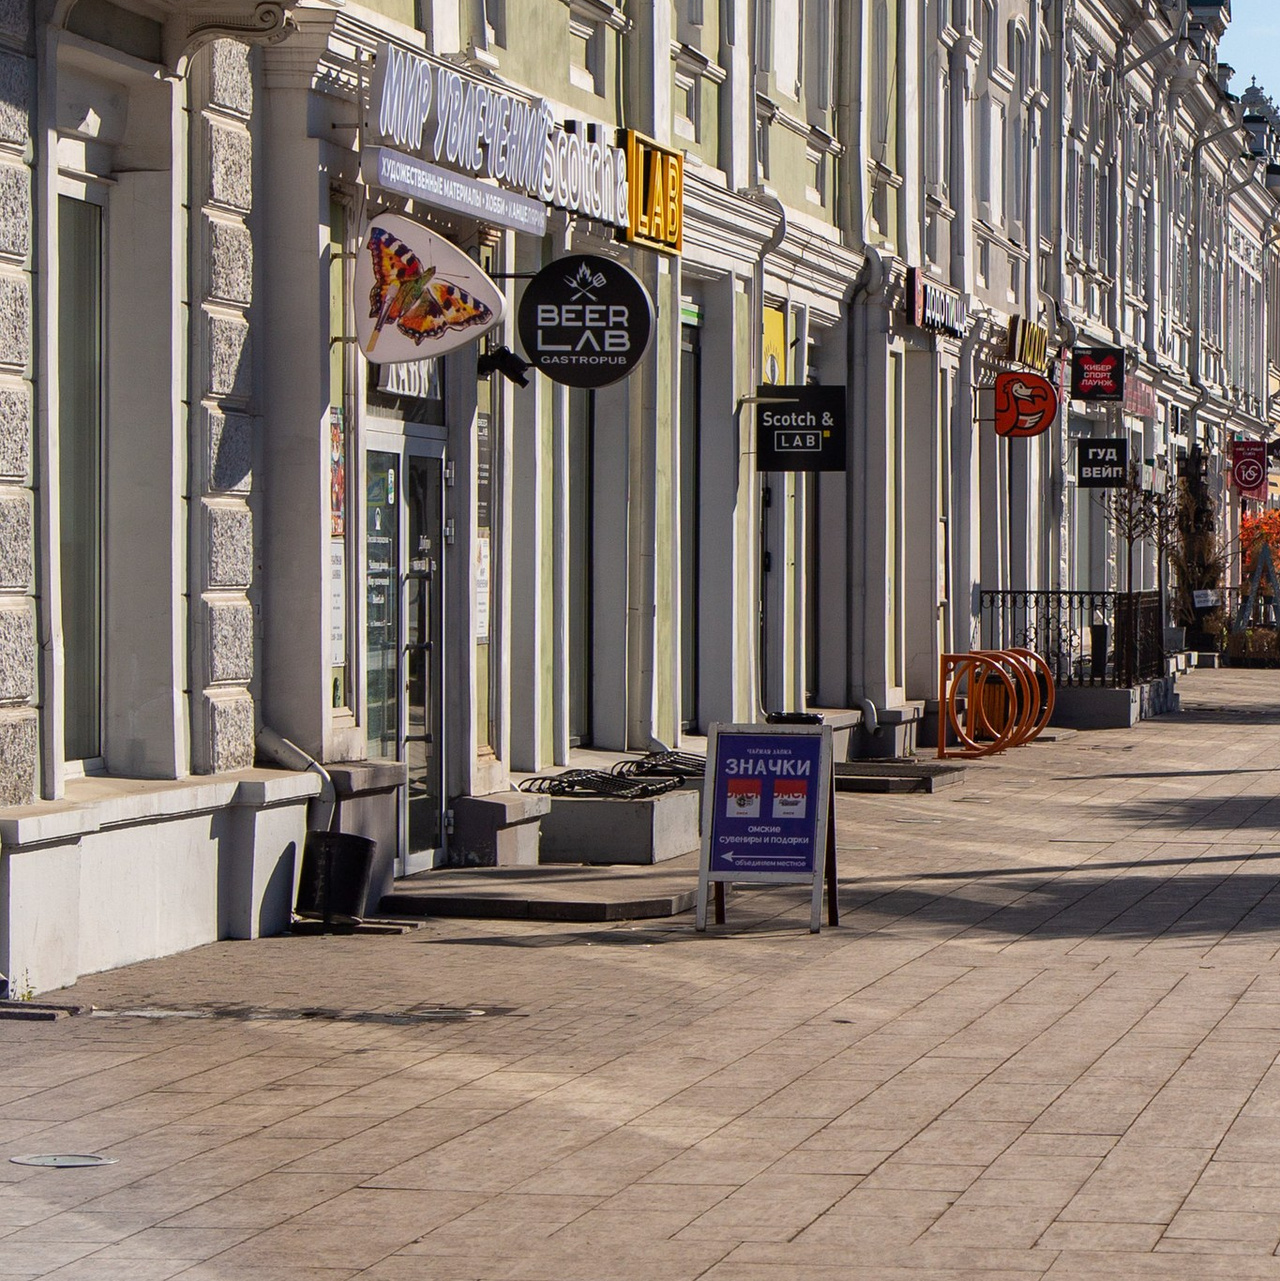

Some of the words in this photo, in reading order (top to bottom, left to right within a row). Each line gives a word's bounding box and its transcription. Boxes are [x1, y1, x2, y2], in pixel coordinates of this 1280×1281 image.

[380, 43, 432, 150] МИР
[434, 67, 553, 197] УВЛЕЧЕНИЙ
[541, 122, 614, 224] Scotch
[381, 157, 443, 195] ХУДОЖЕСТВЕННЫЕ
[443, 177, 482, 208] МАТЕРИАЛЫ
[485, 192, 505, 215] ХОББИ
[638, 143, 679, 243] LAB
[537, 304, 629, 327] BEER
[537, 329, 631, 351] LAB
[540, 355, 627, 365] GASTROPUB
[762, 411, 816, 426] Scotch
[821, 411, 834, 426] &
[781, 435, 816, 447] LAB
[1088, 448, 1117, 461] ГУД
[1082, 465, 1122, 478] ВЕЙП
[725, 758, 811, 776] ЗНАЧКИ
[719, 836, 762, 845] сувениры
[771, 837, 809, 845] подарки
